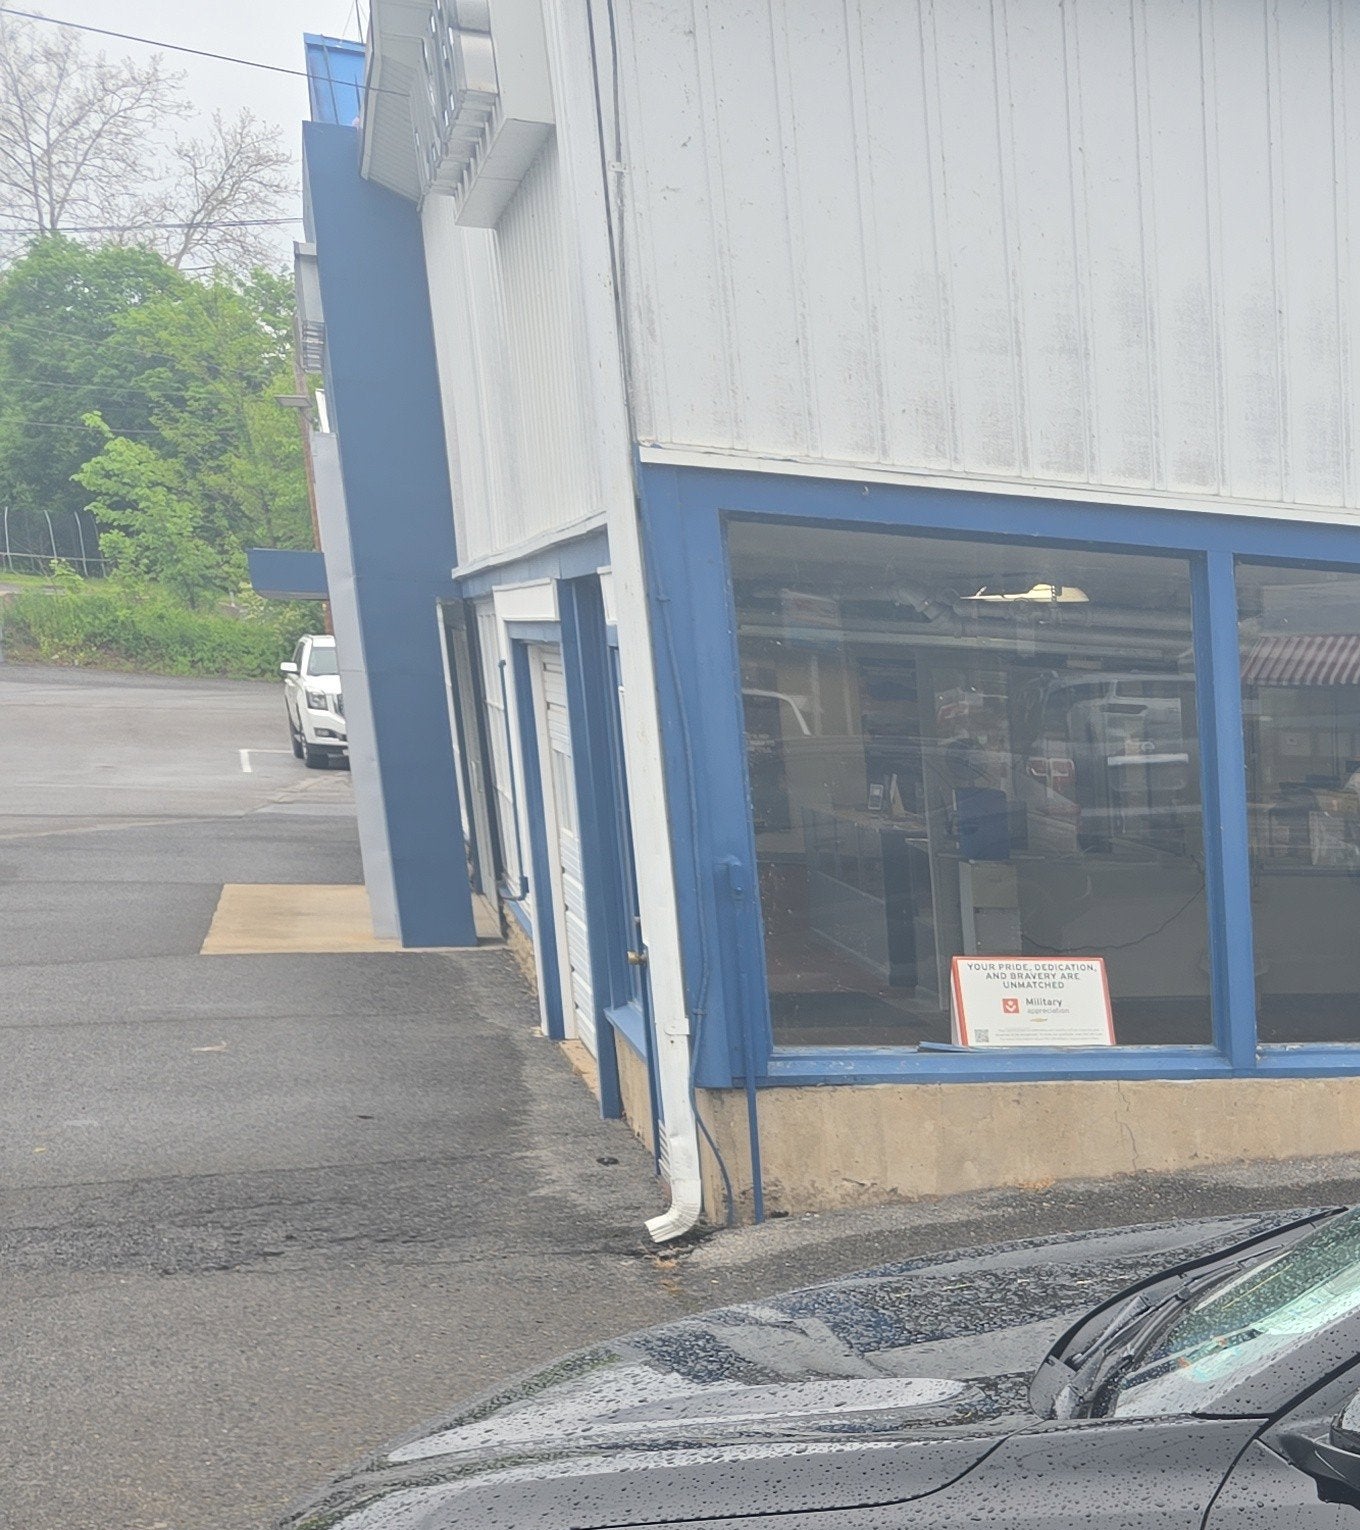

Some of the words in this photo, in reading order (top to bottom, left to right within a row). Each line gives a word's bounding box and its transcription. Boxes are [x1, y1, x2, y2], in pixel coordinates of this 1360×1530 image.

[967, 963, 996, 971] YOUR
[998, 963, 1033, 972] PRIDE,
[1034, 963, 1098, 972] DEDICATION,
[985, 972, 1007, 980] AND
[1010, 972, 1058, 980] BRAVERY
[1060, 972, 1081, 980] ARE
[1002, 981, 1065, 989] UNMATCHED
[1025, 997, 1063, 1007] Military
